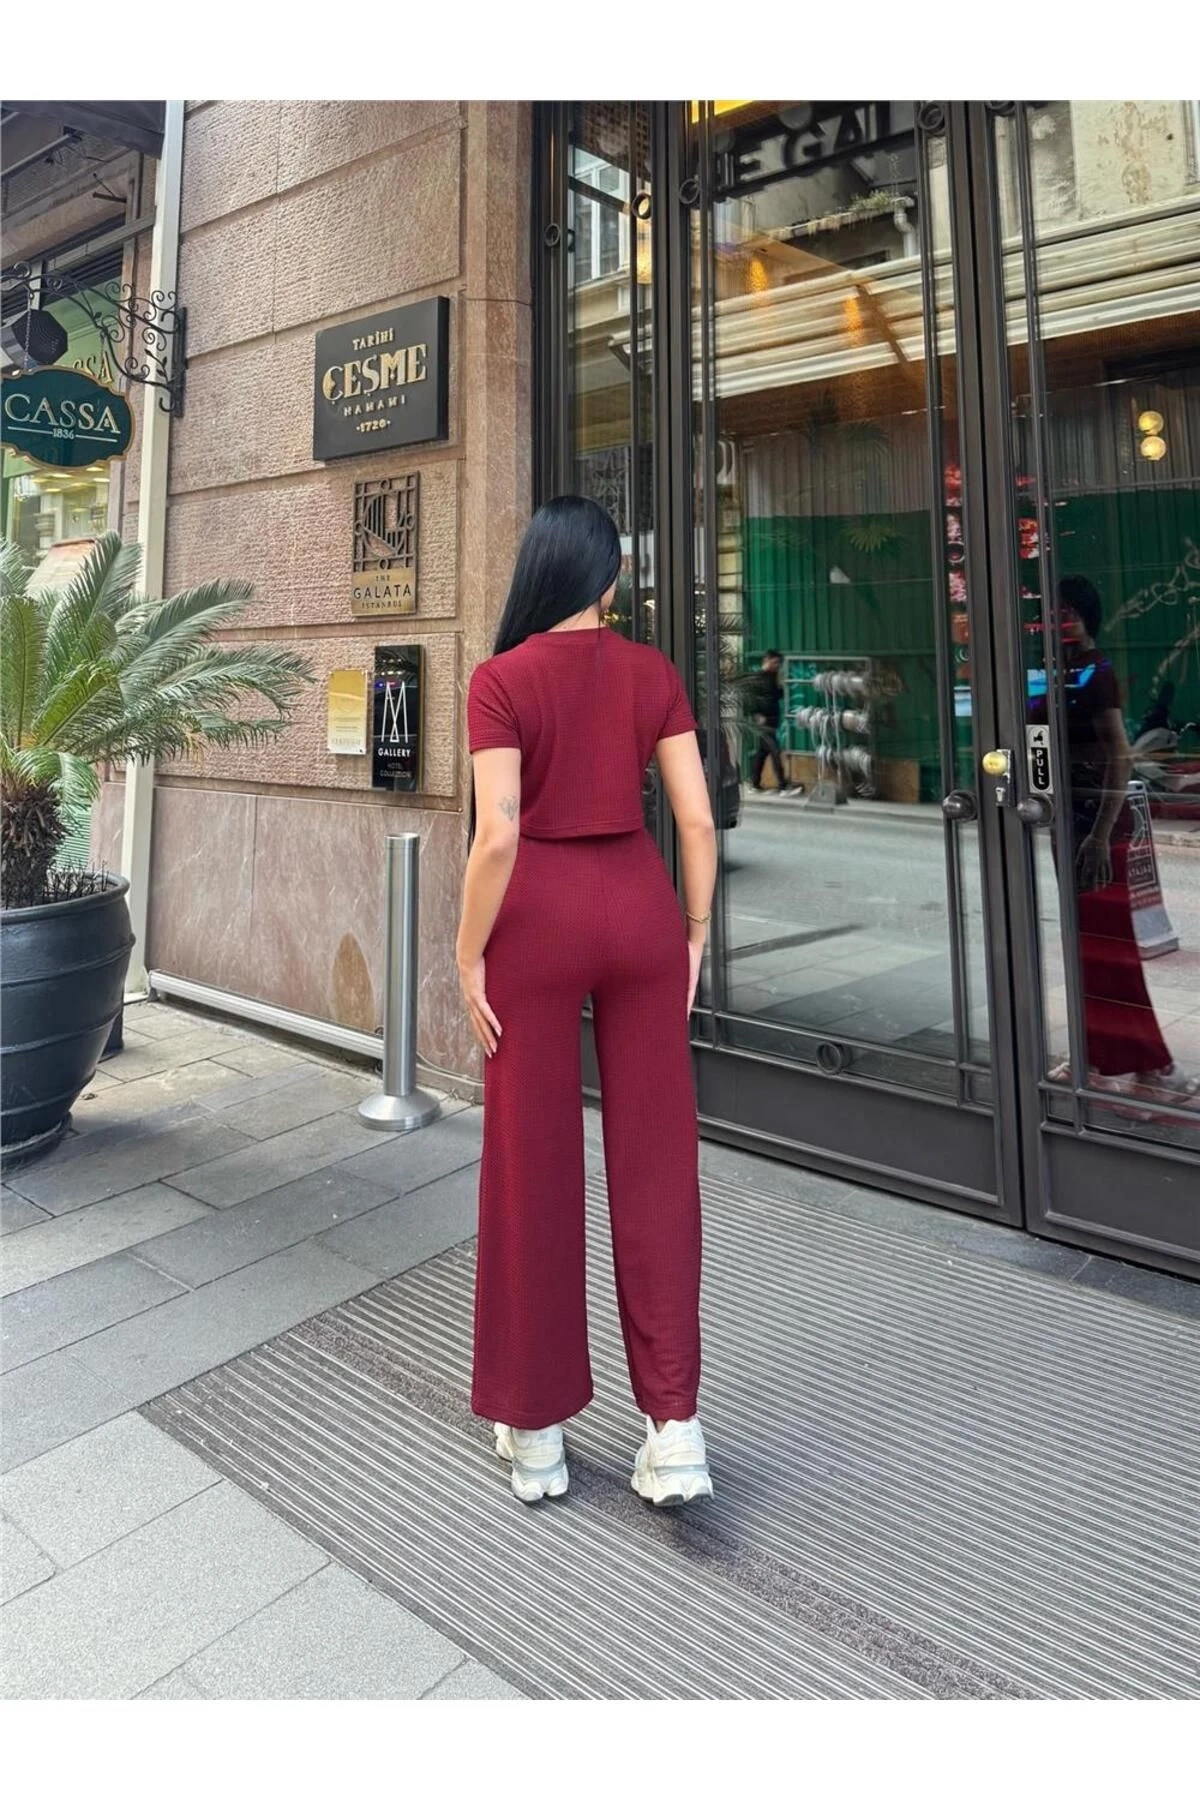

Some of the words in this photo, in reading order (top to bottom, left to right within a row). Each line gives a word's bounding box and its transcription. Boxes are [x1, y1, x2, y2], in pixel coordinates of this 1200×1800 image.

[352, 327, 394, 351] TARİHİ
[322, 343, 427, 405] ÇEŞME
[4, 393, 121, 434] CASSA
[52, 427, 75, 440] 1836
[376, 574, 390, 582] THE
[353, 583, 412, 600] GALATA
[378, 747, 411, 758] GALLERY
[1036, 749, 1045, 785] PULL
